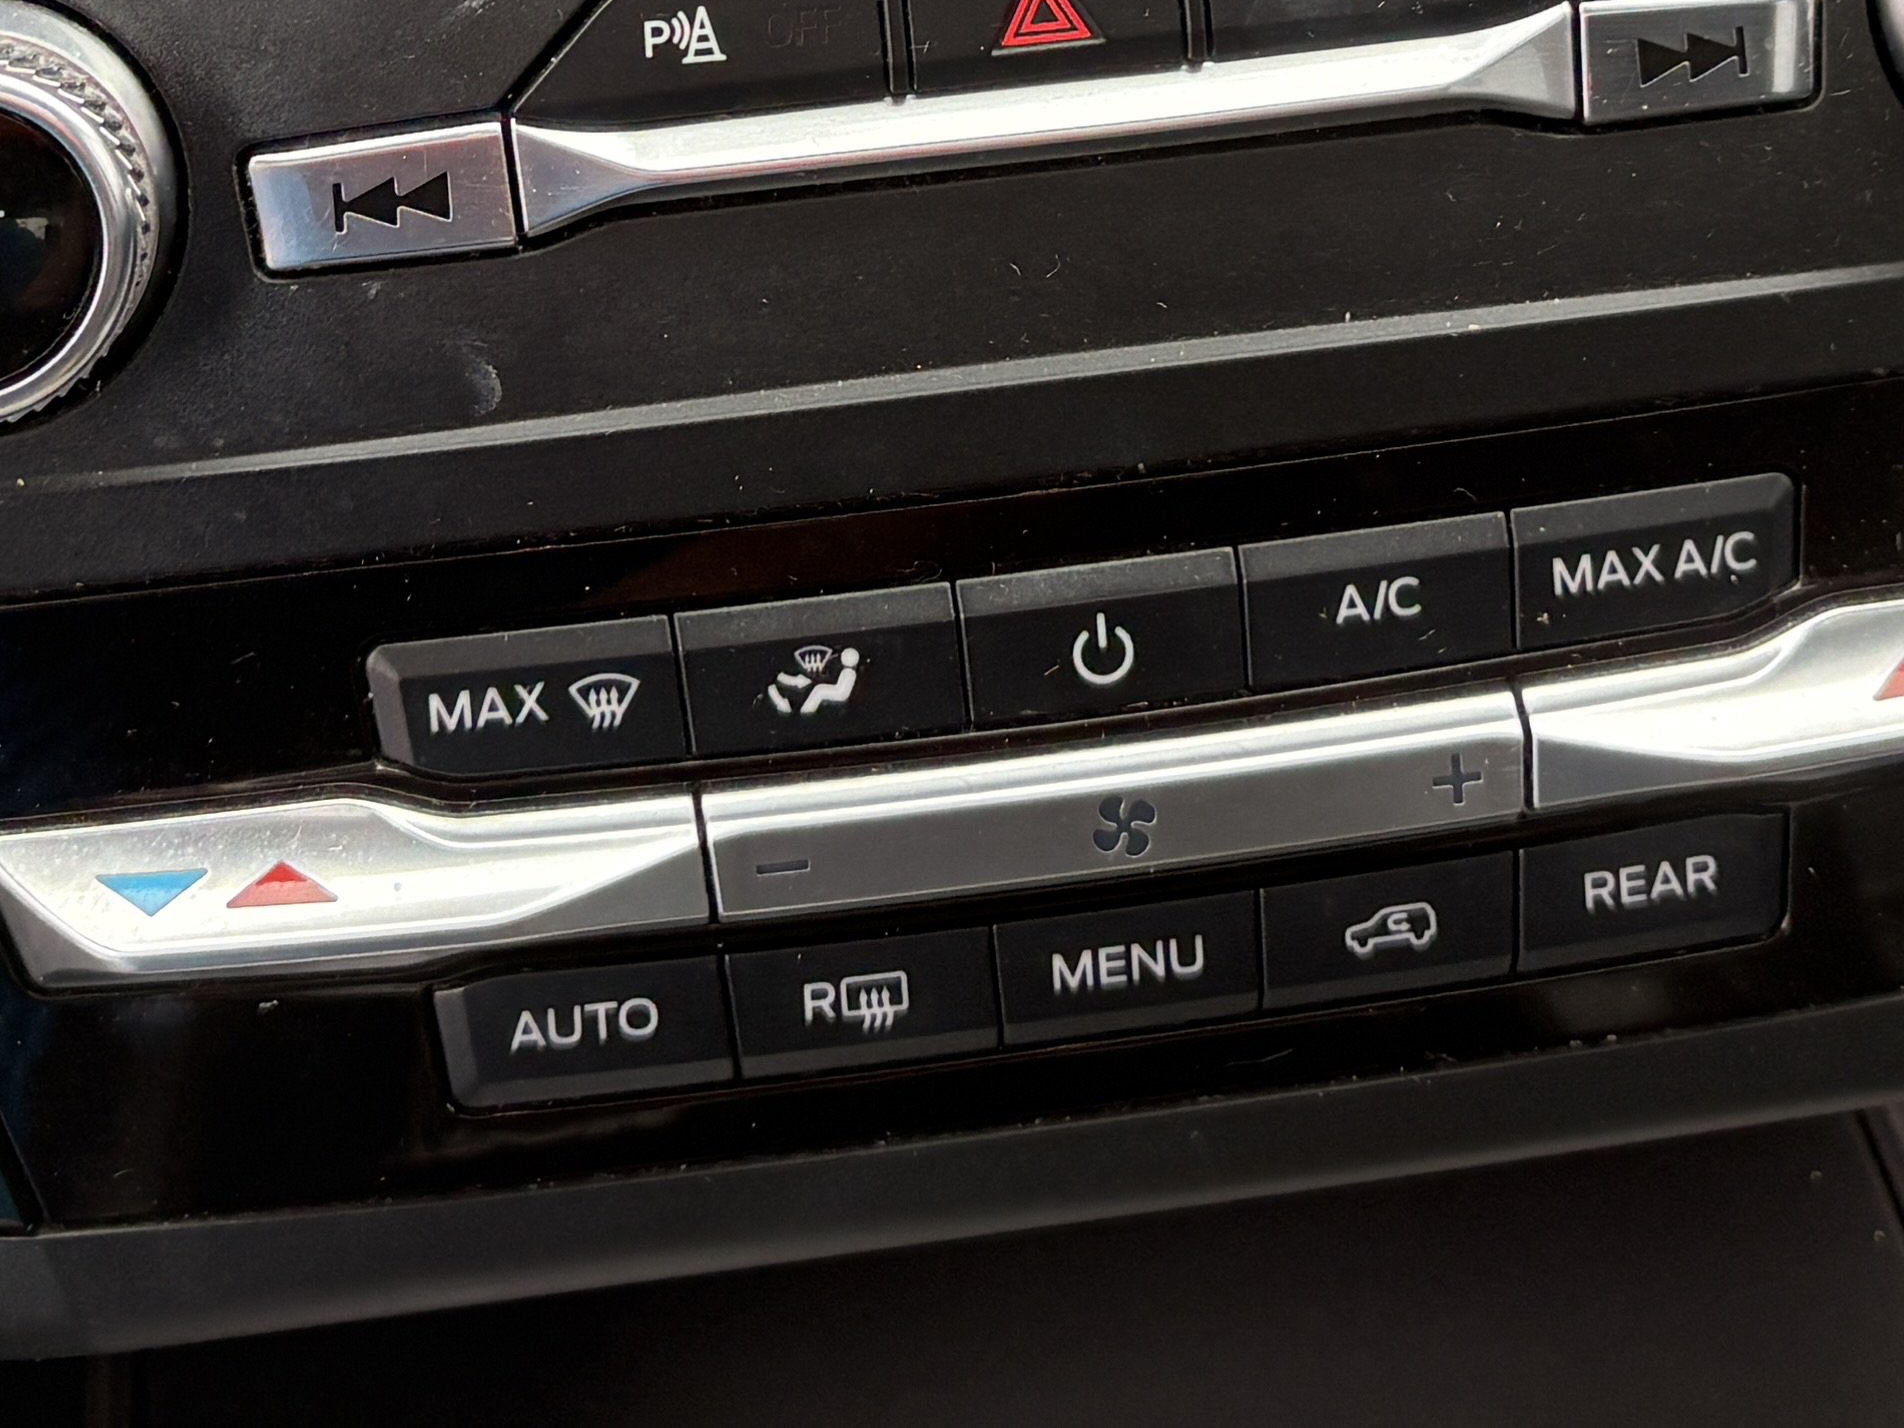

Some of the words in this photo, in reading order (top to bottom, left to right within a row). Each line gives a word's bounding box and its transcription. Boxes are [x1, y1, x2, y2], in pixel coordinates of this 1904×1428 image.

[1551, 544, 1664, 599] MAX
[1673, 530, 1759, 579] A/C
[1336, 576, 1422, 627] A/C
[428, 680, 549, 735] MAX
[1583, 854, 1719, 914] REAR
[1050, 934, 1206, 996] MENU
[509, 996, 659, 1053] AUTO
